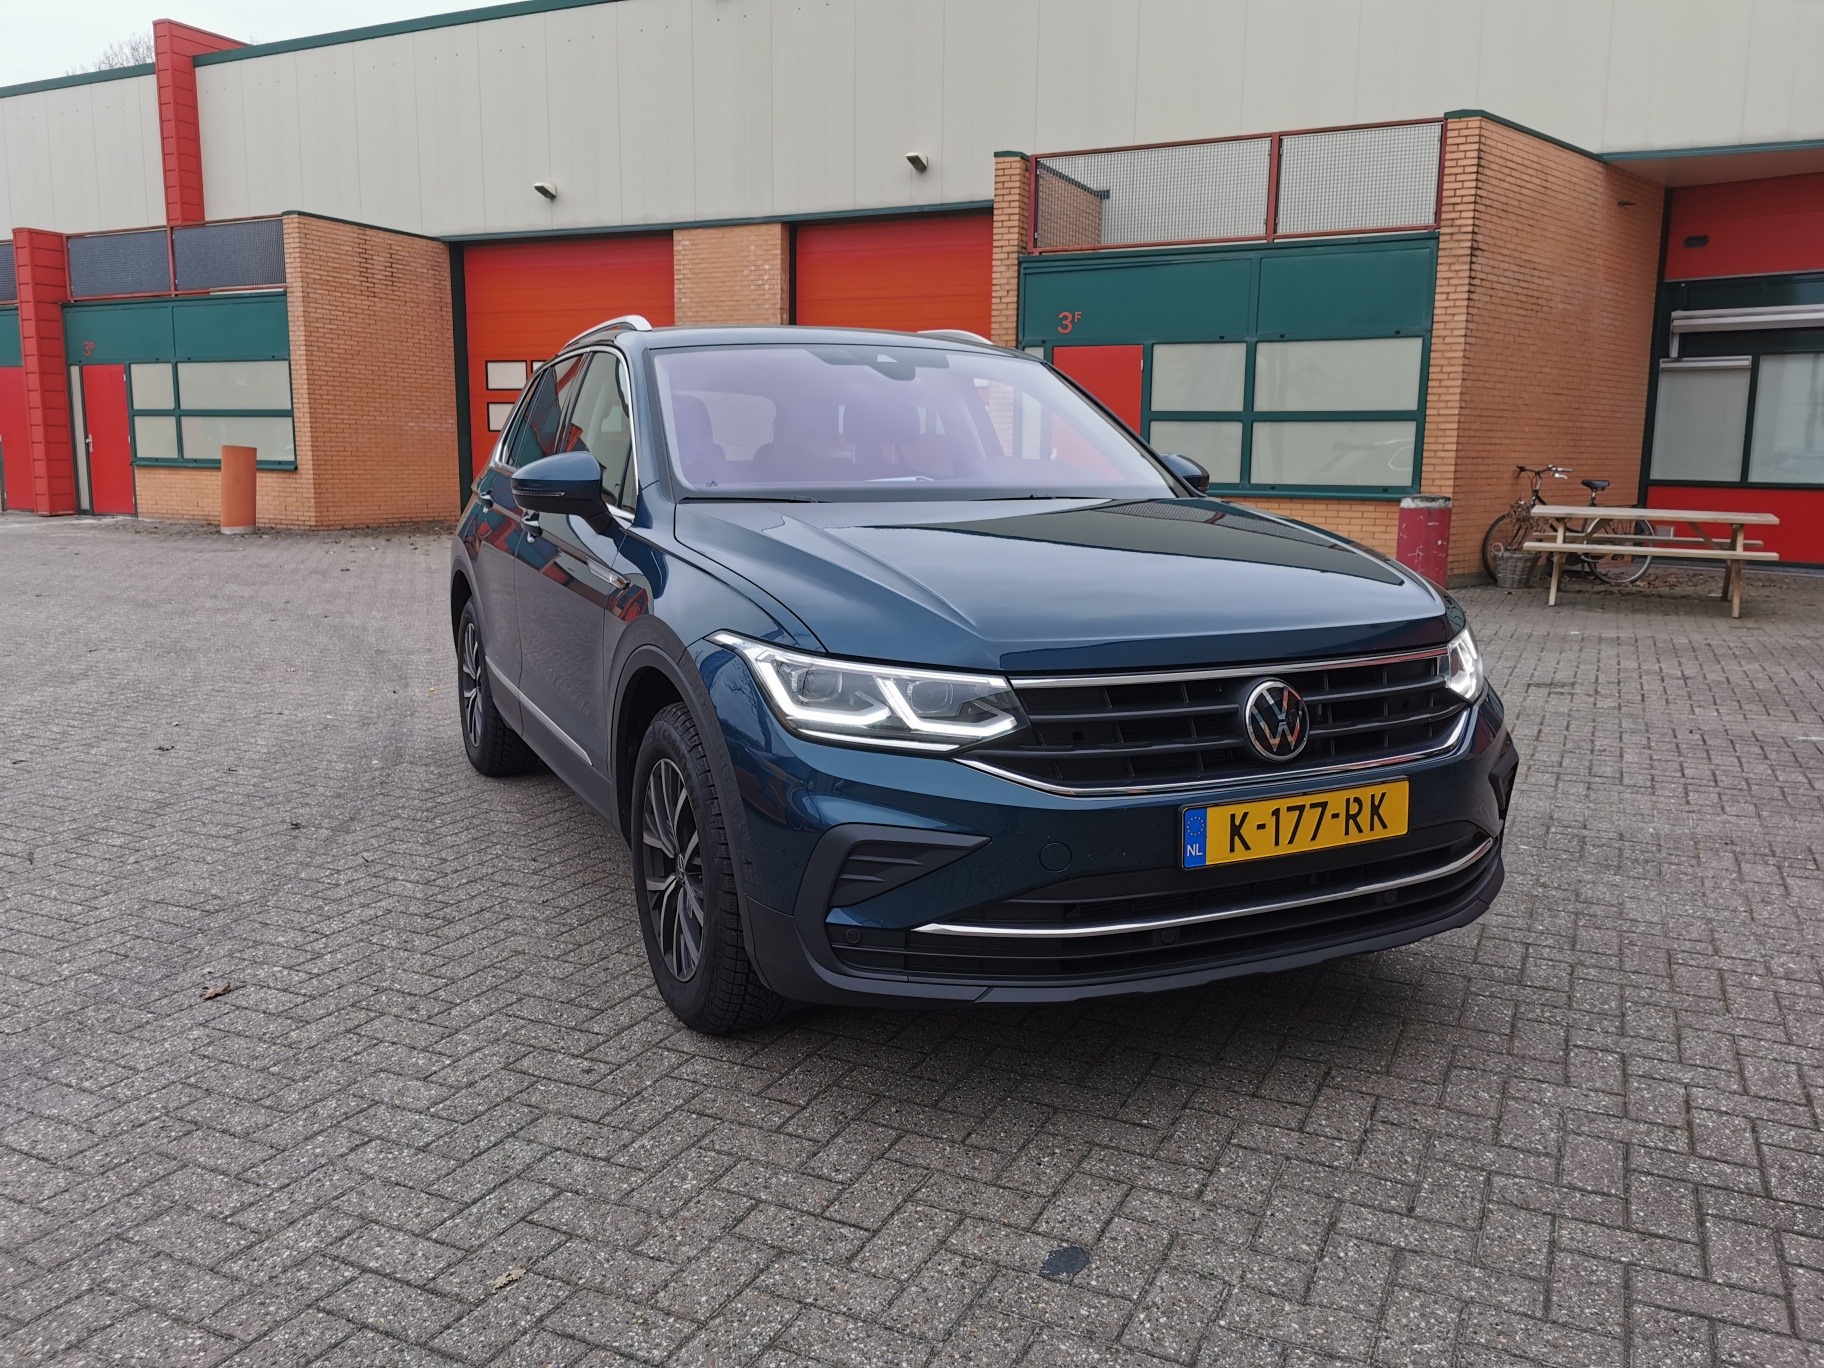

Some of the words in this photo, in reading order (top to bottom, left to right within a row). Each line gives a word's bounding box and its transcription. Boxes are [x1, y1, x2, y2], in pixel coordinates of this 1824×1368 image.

[1057, 311, 1082, 334] 3F
[1228, 791, 1388, 854] K-177-RK
[1186, 843, 1203, 857] NL
